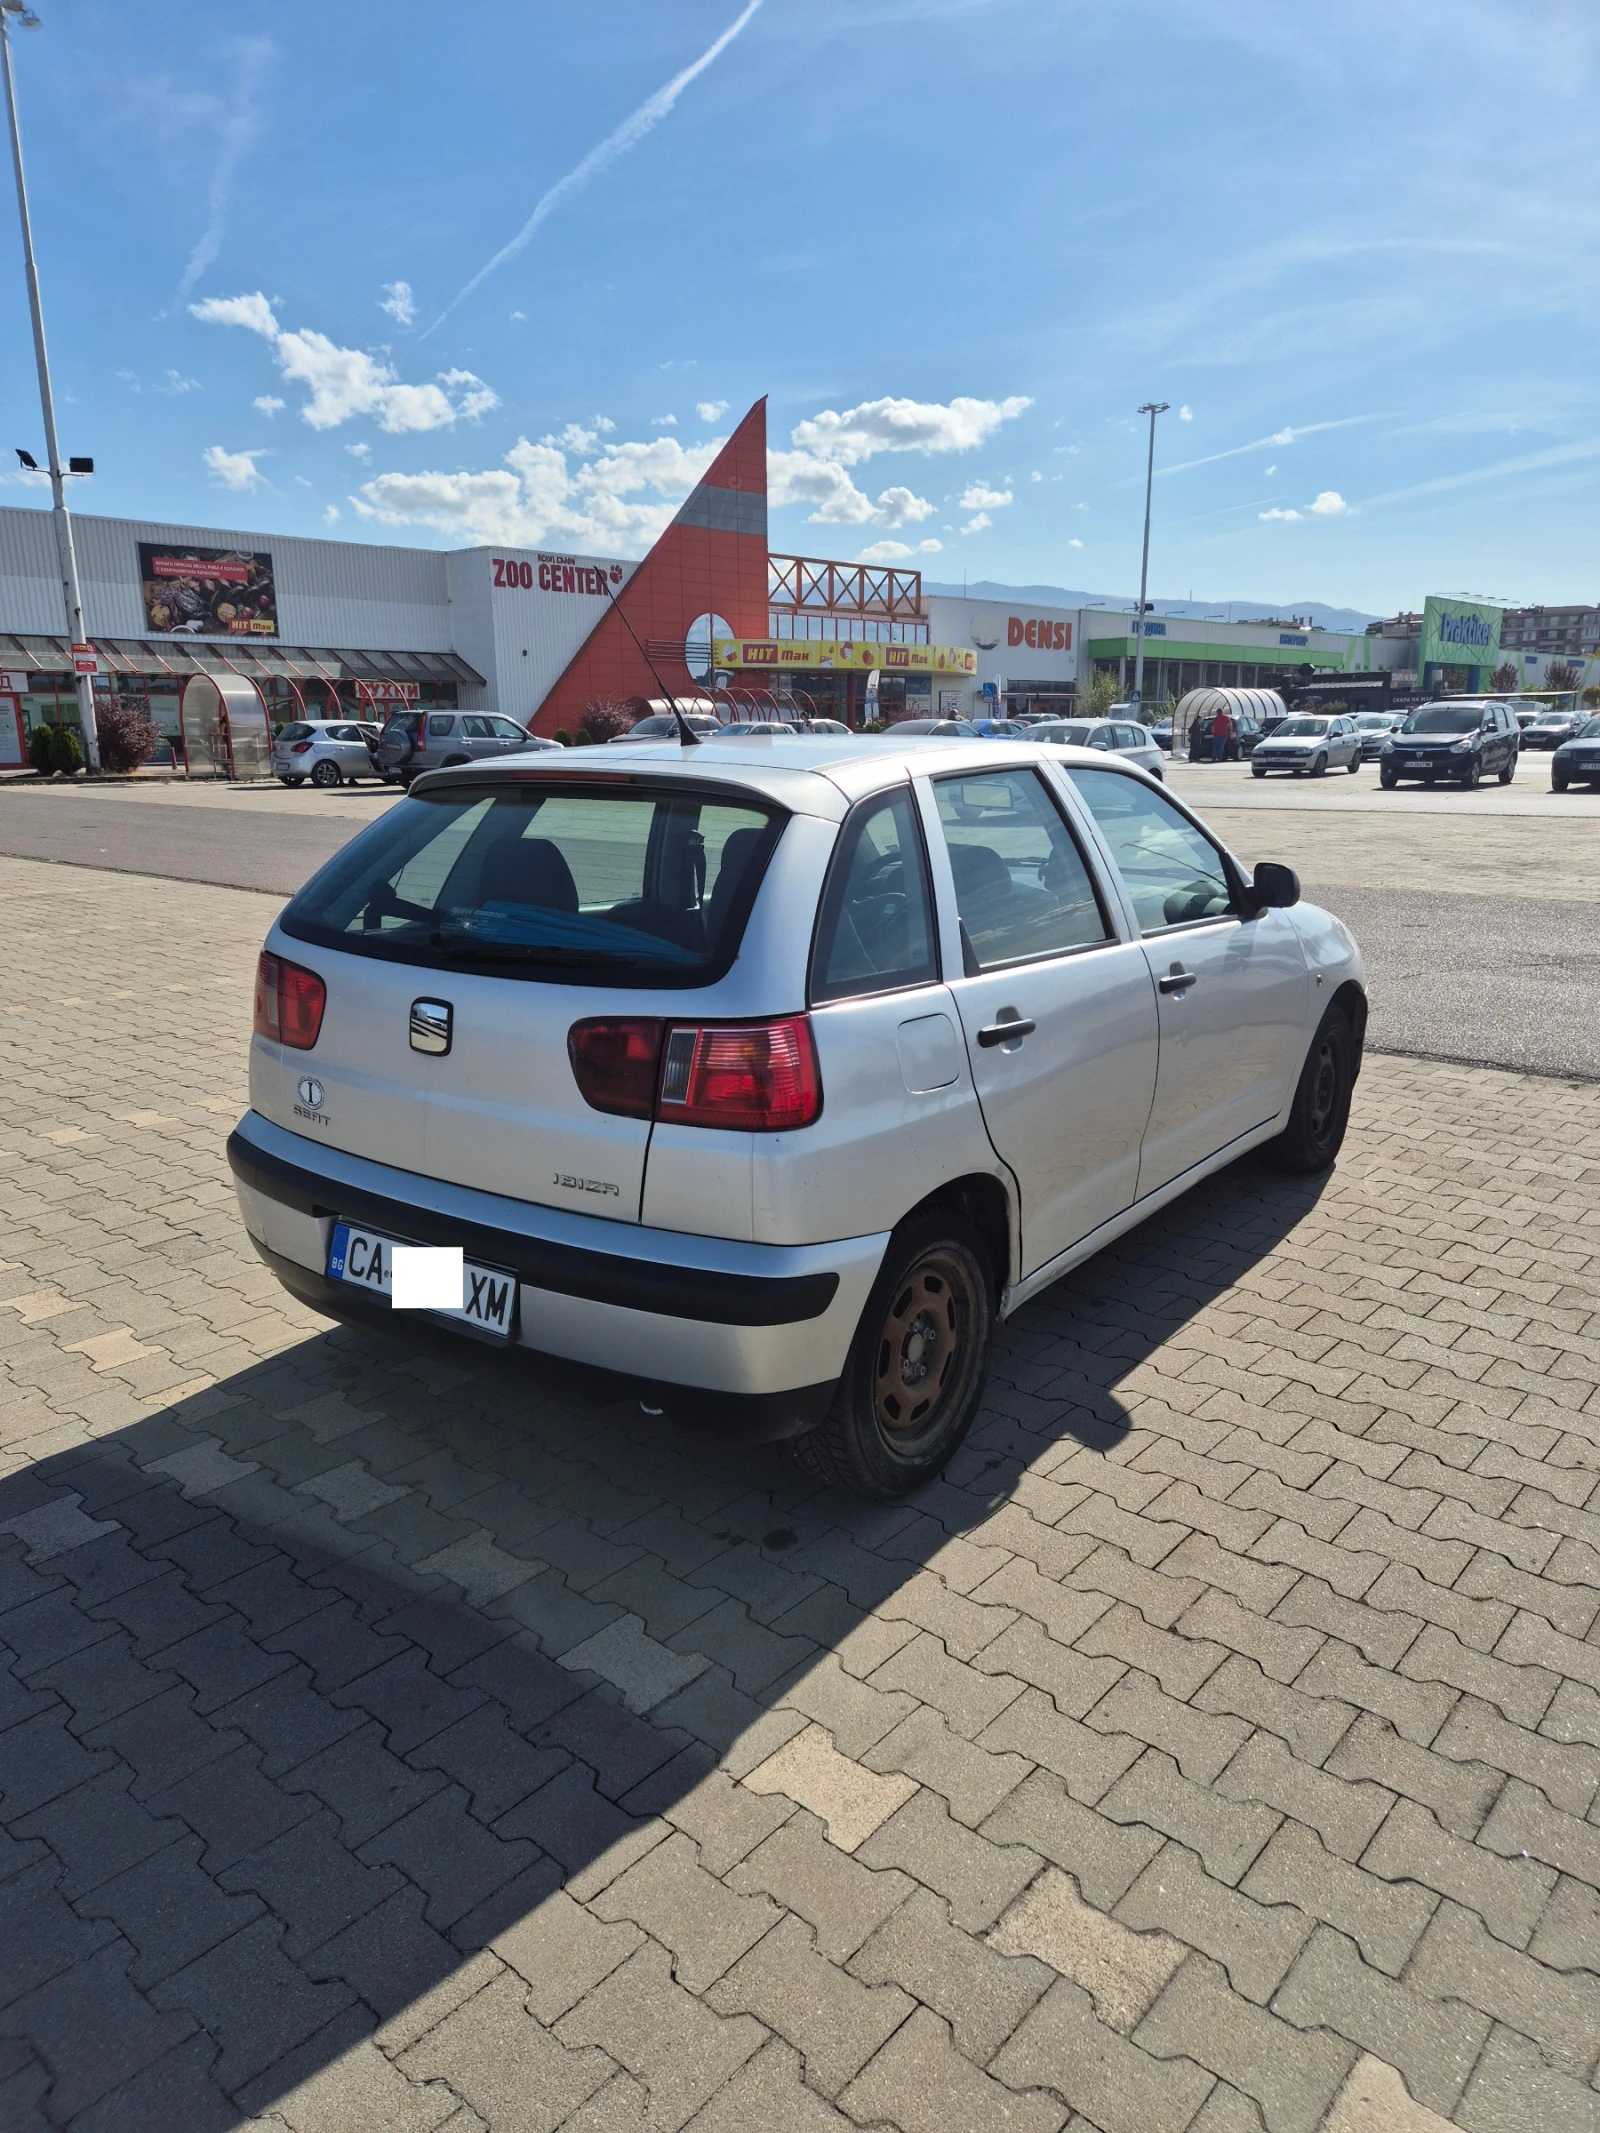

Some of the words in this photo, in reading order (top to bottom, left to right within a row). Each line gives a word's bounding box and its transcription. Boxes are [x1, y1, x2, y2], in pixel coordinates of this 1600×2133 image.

[537, 554, 556, 564] ROYAL
[492, 558, 533, 589] ZOO
[538, 563, 609, 596] CENTER
[231, 620, 249, 630] HIT
[1007, 617, 1073, 650] DENSI
[747, 648, 774, 661] HIT
[889, 651, 906, 663] HIT
[293, 1104, 331, 1126] SEAT
[552, 1173, 620, 1196] IBIZA
[331, 1256, 343, 1272] BG
[465, 1271, 509, 1326] XM
